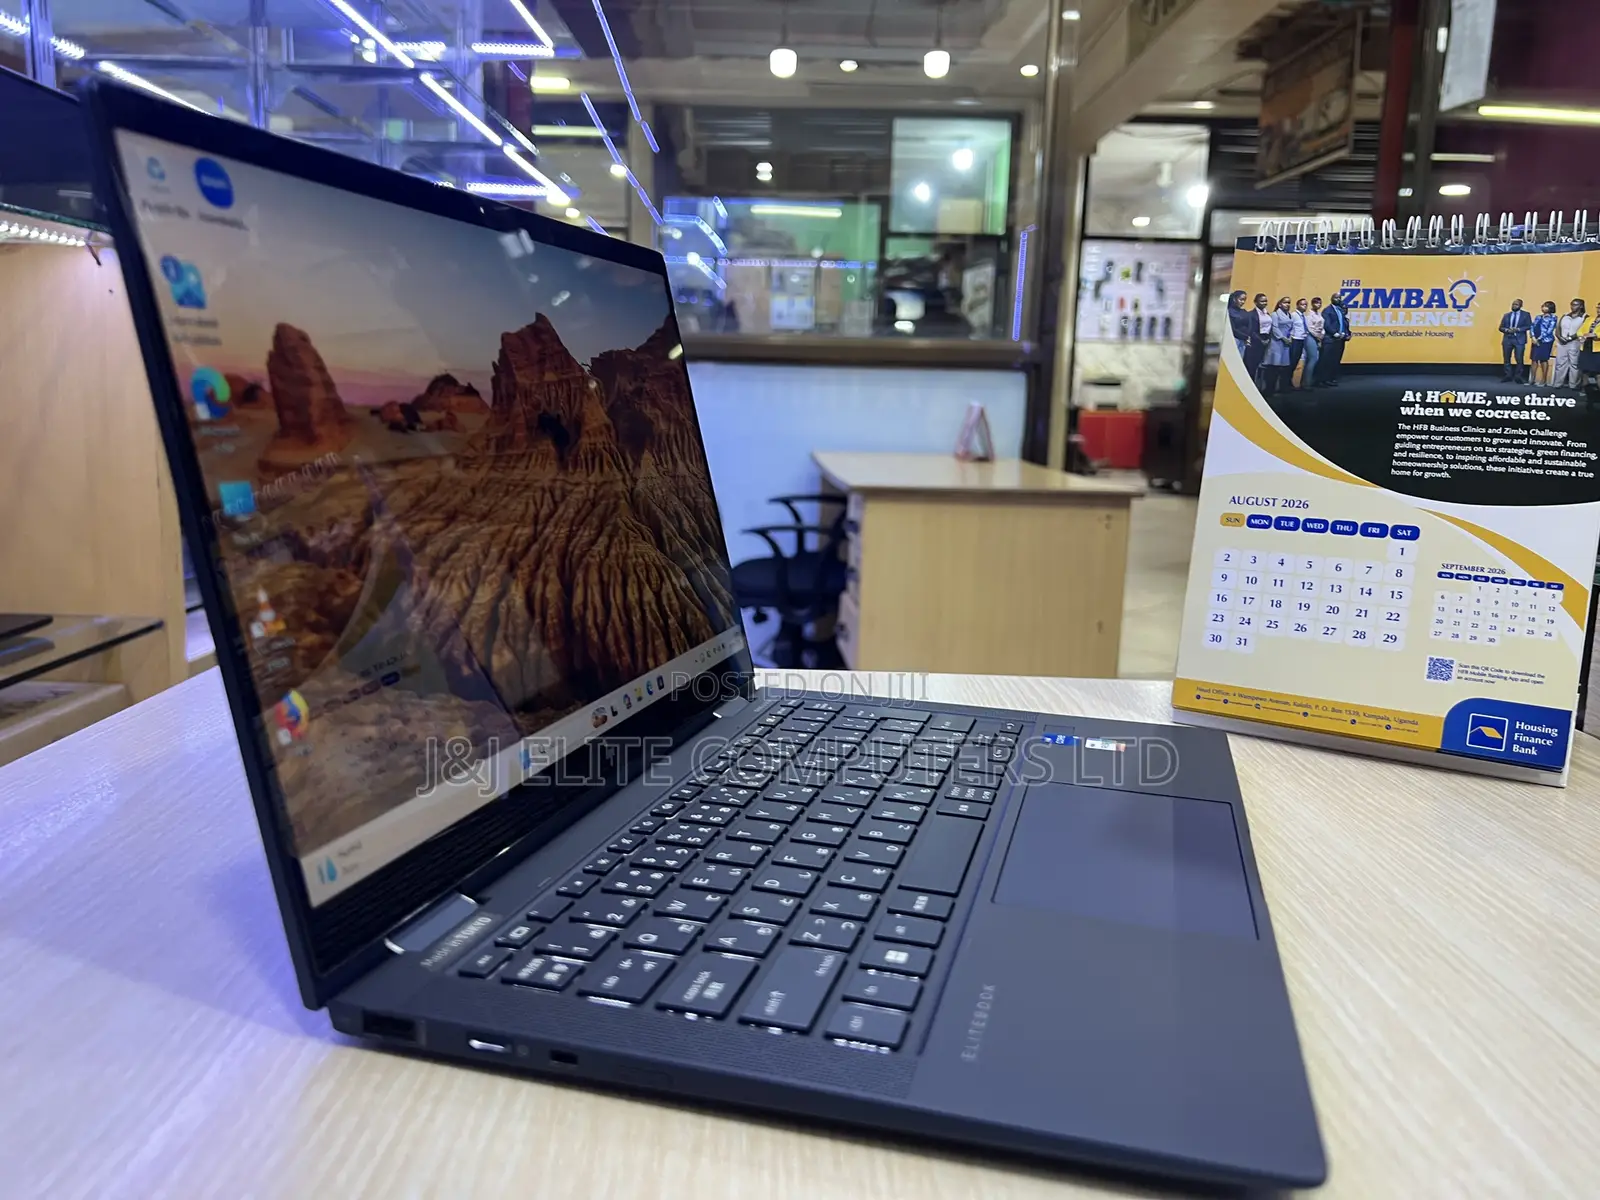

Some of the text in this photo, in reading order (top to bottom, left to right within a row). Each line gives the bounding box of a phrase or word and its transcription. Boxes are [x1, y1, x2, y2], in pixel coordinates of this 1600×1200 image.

[1340, 288, 1448, 308] ZIMBA
[1350, 311, 1474, 327] HALLENGE
[1401, 390, 1422, 402] At
[1496, 396, 1520, 405] we
[1524, 393, 1576, 408] thrive
[1400, 404, 1551, 420] when we cocreate.
[1530, 429, 1567, 438] Challenge
[1394, 442, 1420, 450] guiding
[1529, 438, 1564, 446] innovate.
[1392, 460, 1448, 470] homeownership
[1450, 463, 1484, 471] solutions,
[1508, 466, 1543, 474] initiatives
[1456, 454, 1486, 463] inspiring
[1488, 455, 1526, 463] affordable
[1544, 459, 1586, 467] sustainable
[1229, 496, 1309, 509] AUGUST 2026
[1400, 547, 1404, 555] 1
[1224, 553, 1403, 578] 2 3 4 5 6 7 8
[1441, 563, 1485, 573] SEPTEMBER
[1221, 574, 1403, 600] 9 10 11 12 13 14 15
[1216, 594, 1400, 622] 16 17 18 19 20 21 22
[1212, 613, 1397, 643] 23 24 25 26 27 28 29
[1209, 634, 1247, 646] 30 31
[1516, 721, 1558, 737] Housing
[1514, 733, 1553, 746] Finance
[1512, 744, 1538, 755] Bank
[960, 983, 996, 1062] ELITEBOOK
